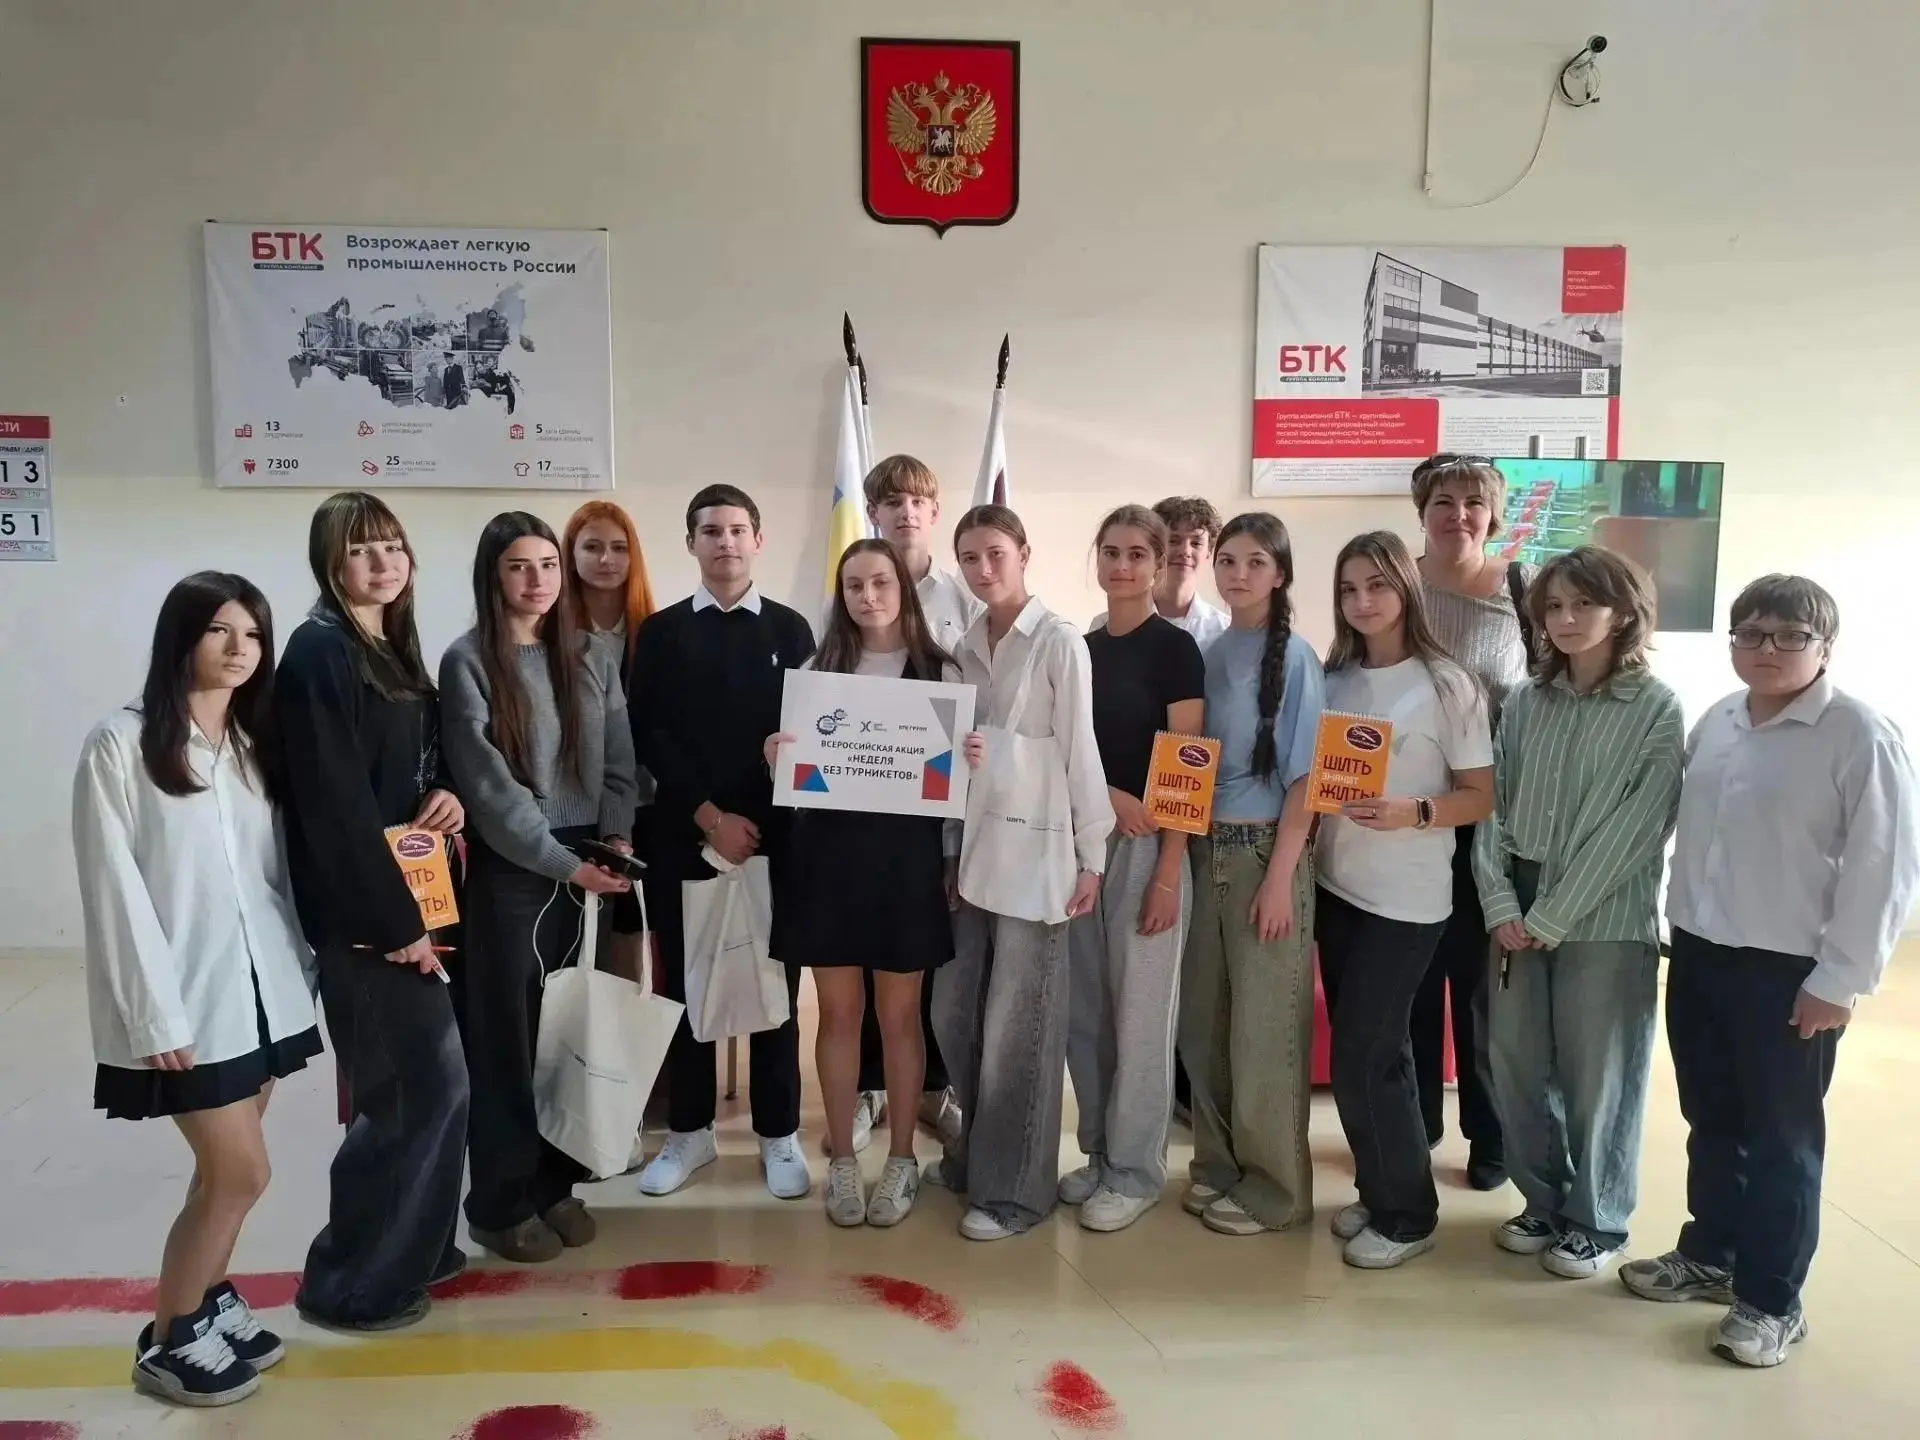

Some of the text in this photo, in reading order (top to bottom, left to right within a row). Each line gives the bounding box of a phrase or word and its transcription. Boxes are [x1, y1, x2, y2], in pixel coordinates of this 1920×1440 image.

[251, 232, 324, 261] БТК
[346, 235, 531, 254] Возрождает легкую
[347, 258, 576, 274] промышленность России
[1280, 345, 1347, 373] БТК
[1334, 411, 1351, 419] БТК
[265, 421, 280, 431] 13
[536, 423, 543, 434] 5
[267, 458, 299, 469] 7300
[386, 455, 400, 466] 25
[537, 460, 551, 471] 17
[821, 740, 925, 755] ВСЕРОССИЙСКАЯ АКЦИЯ
[848, 754, 894, 766] «НЕДЕЛЯ
[1323, 754, 1372, 776] ШИТЬ
[823, 765, 918, 780] БЕЗ ТУРНИКЕТОВ»
[1158, 772, 1202, 791] ШИТЬ
[1154, 799, 1205, 820] ЖИТЬ!
